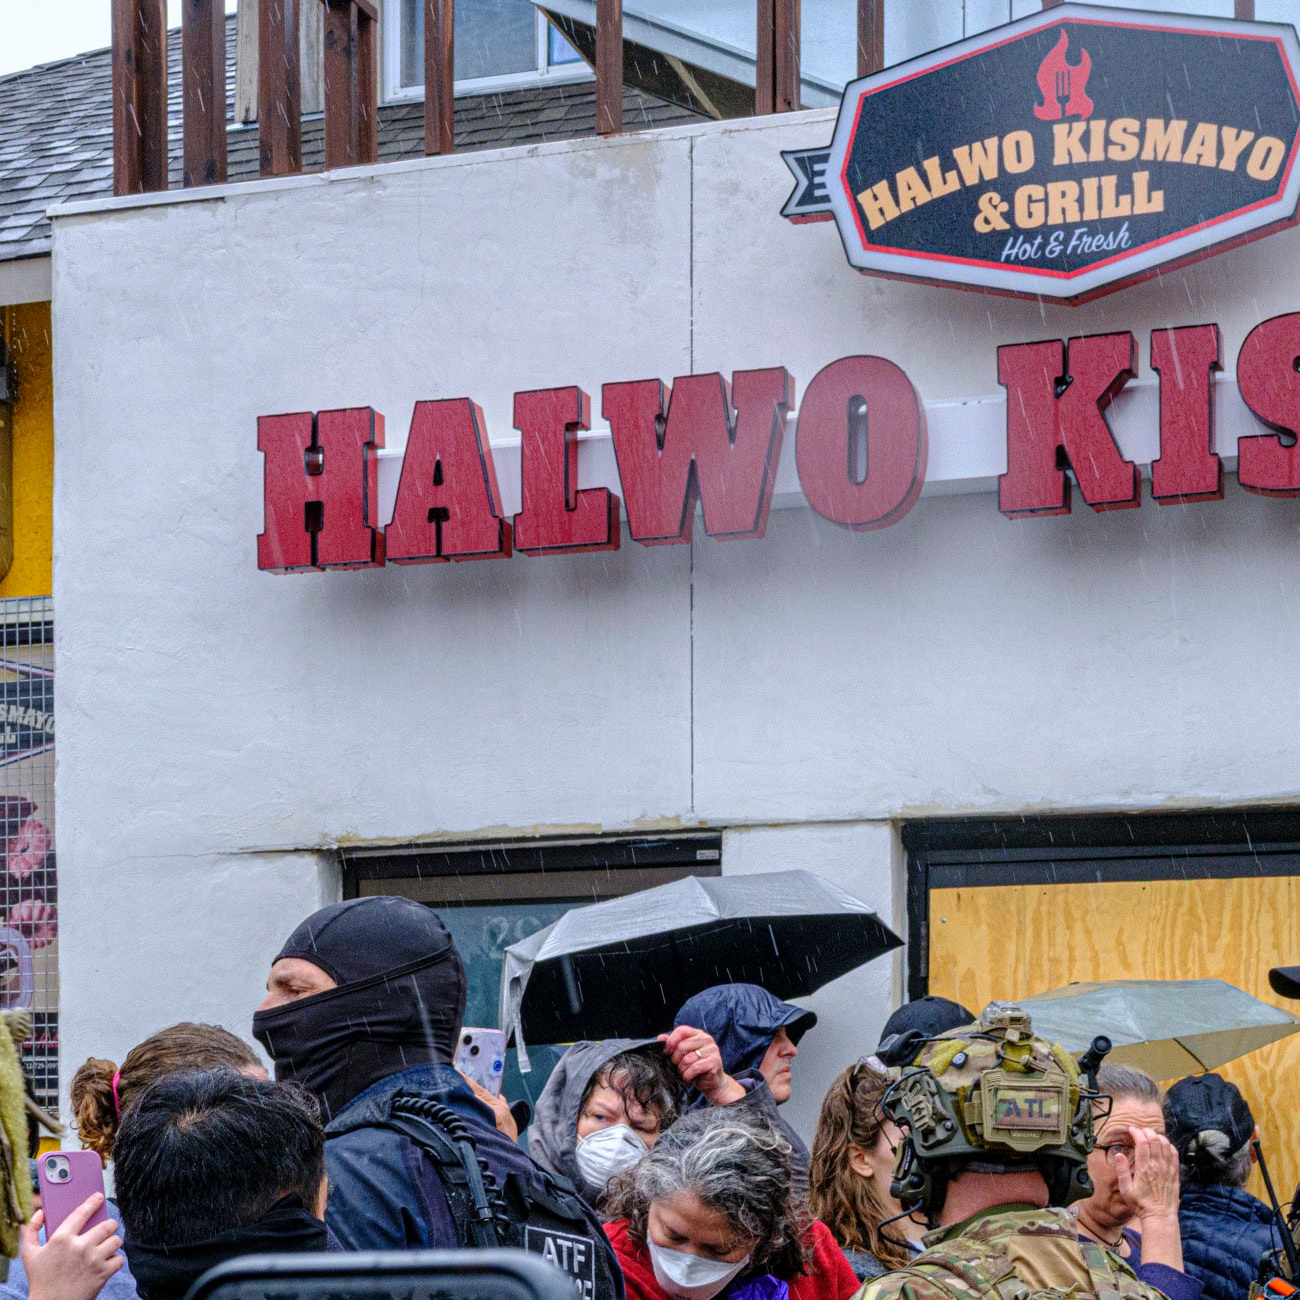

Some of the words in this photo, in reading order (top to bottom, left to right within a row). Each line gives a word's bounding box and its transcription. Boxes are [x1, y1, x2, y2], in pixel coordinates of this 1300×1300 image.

[856, 130, 1036, 232] HALWO
[1052, 118, 1287, 182] KISMAYO
[1001, 233, 1042, 264] Hot
[1045, 230, 1067, 258] &
[1067, 221, 1132, 256] Fresh
[256, 354, 929, 576] HALWO
[542, 1236, 586, 1273] ATF
